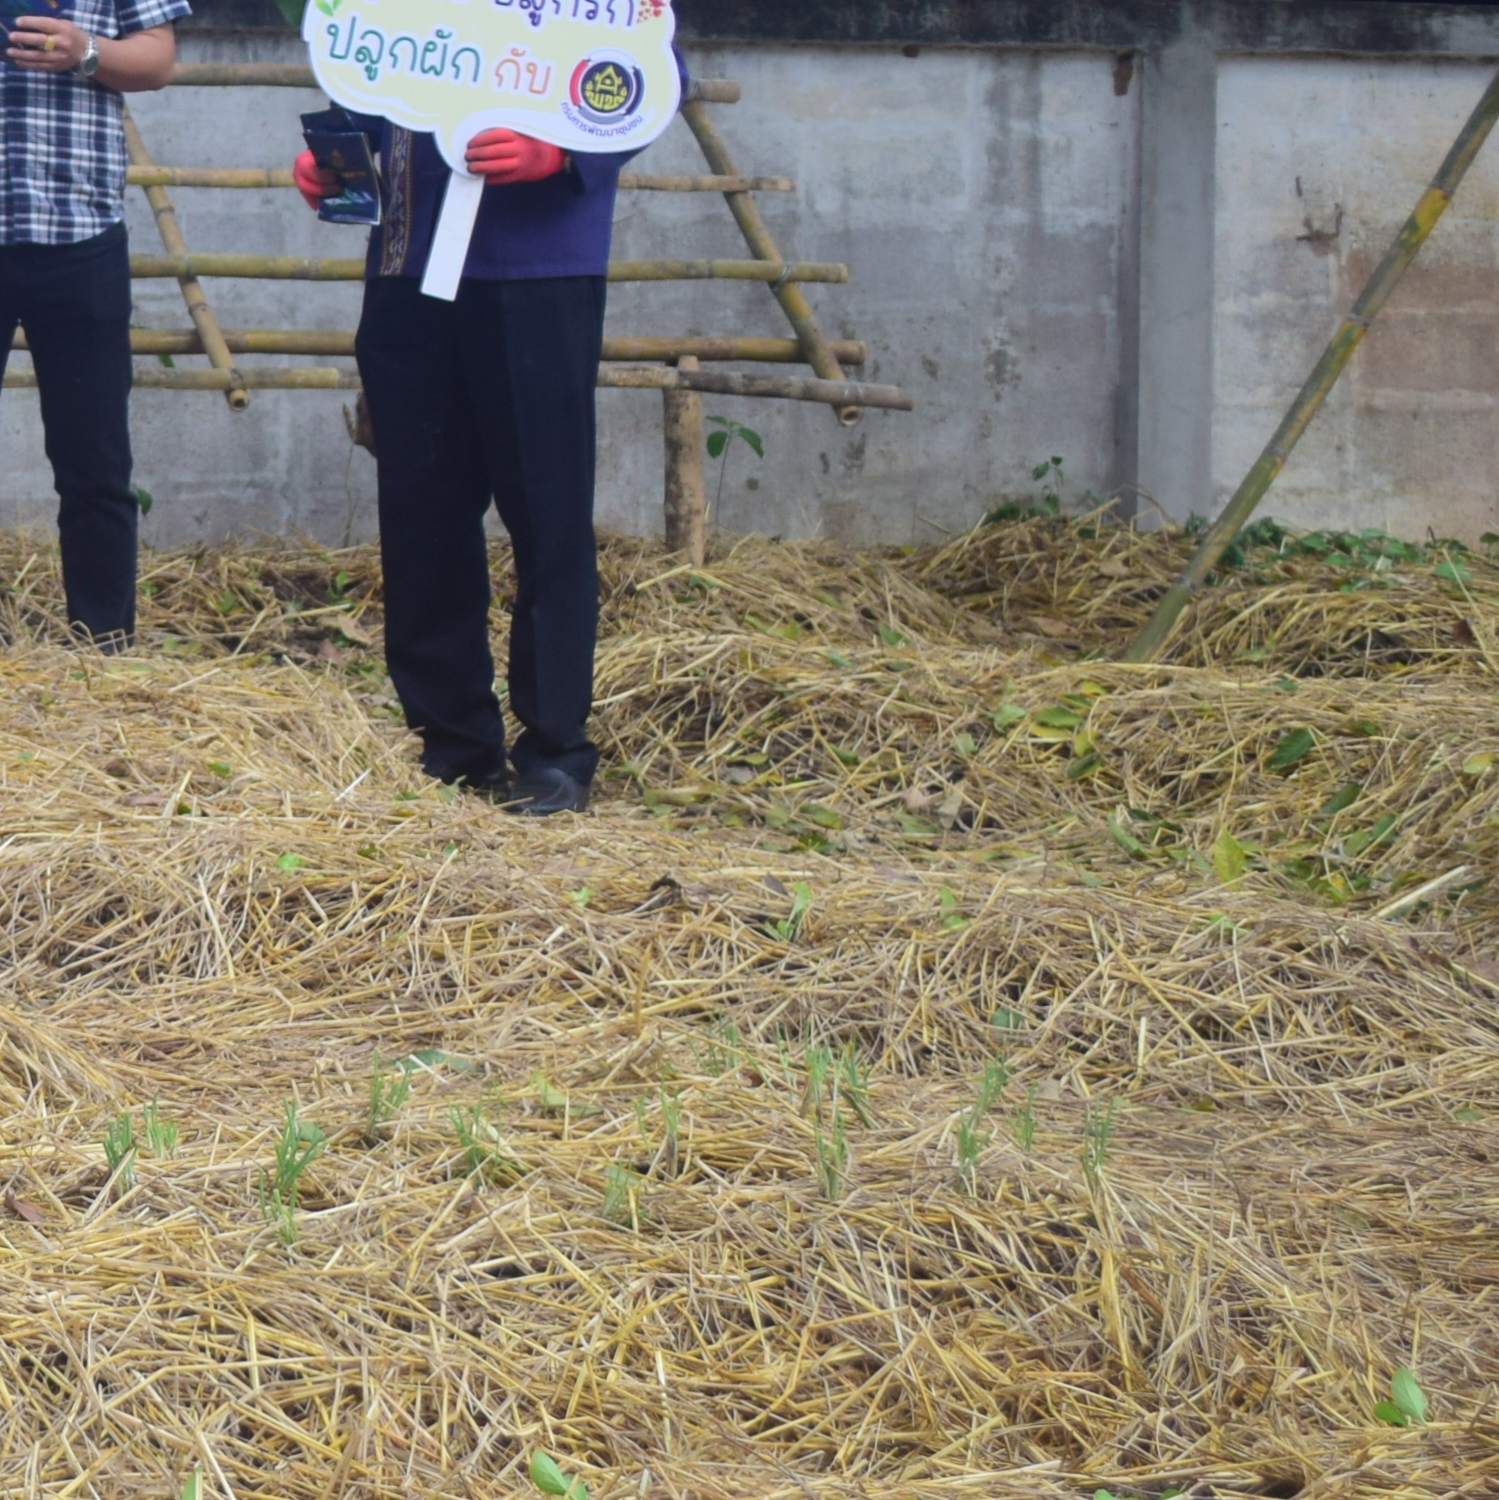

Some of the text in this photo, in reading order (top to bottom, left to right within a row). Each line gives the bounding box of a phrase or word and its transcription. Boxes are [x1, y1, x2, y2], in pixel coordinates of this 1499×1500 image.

[325, 15, 552, 96] ปลูกผัก กับ
[560, 101, 643, 138] กรมการพัฒนาชุมชน
